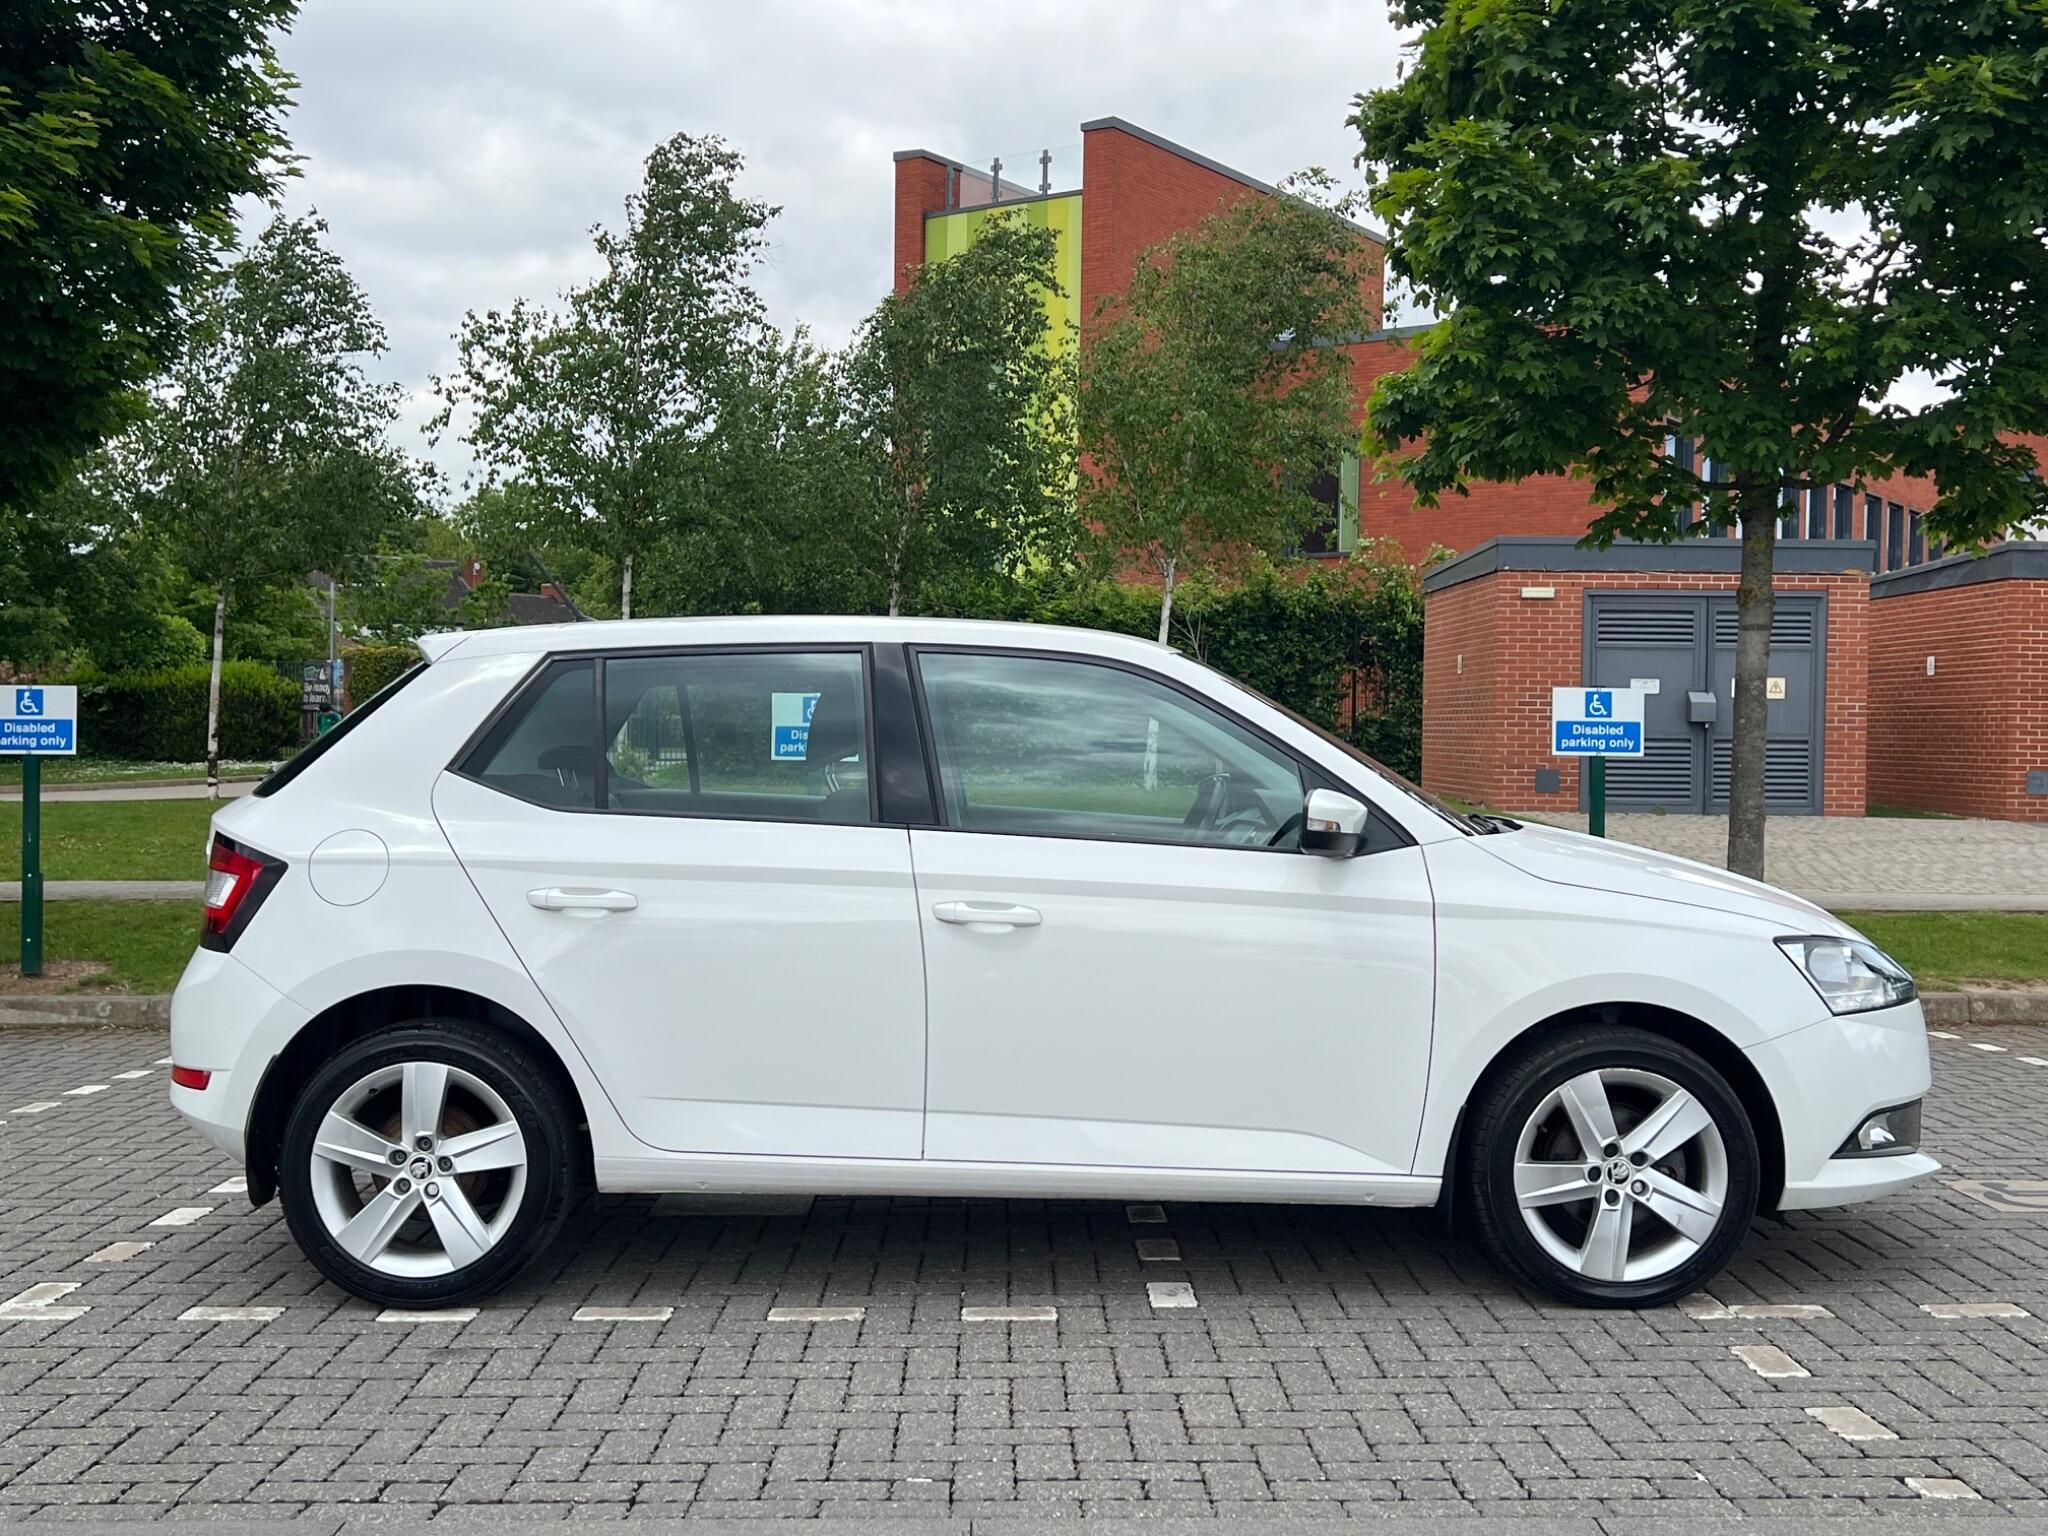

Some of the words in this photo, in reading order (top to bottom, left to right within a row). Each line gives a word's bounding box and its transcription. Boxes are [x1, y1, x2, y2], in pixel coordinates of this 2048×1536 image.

[4, 722, 55, 733] Disabled
[1572, 724, 1624, 735] Disabled
[0, 735, 37, 748] arking
[40, 736, 67, 747] only
[1561, 737, 1605, 750] parking
[1609, 738, 1634, 750] only
